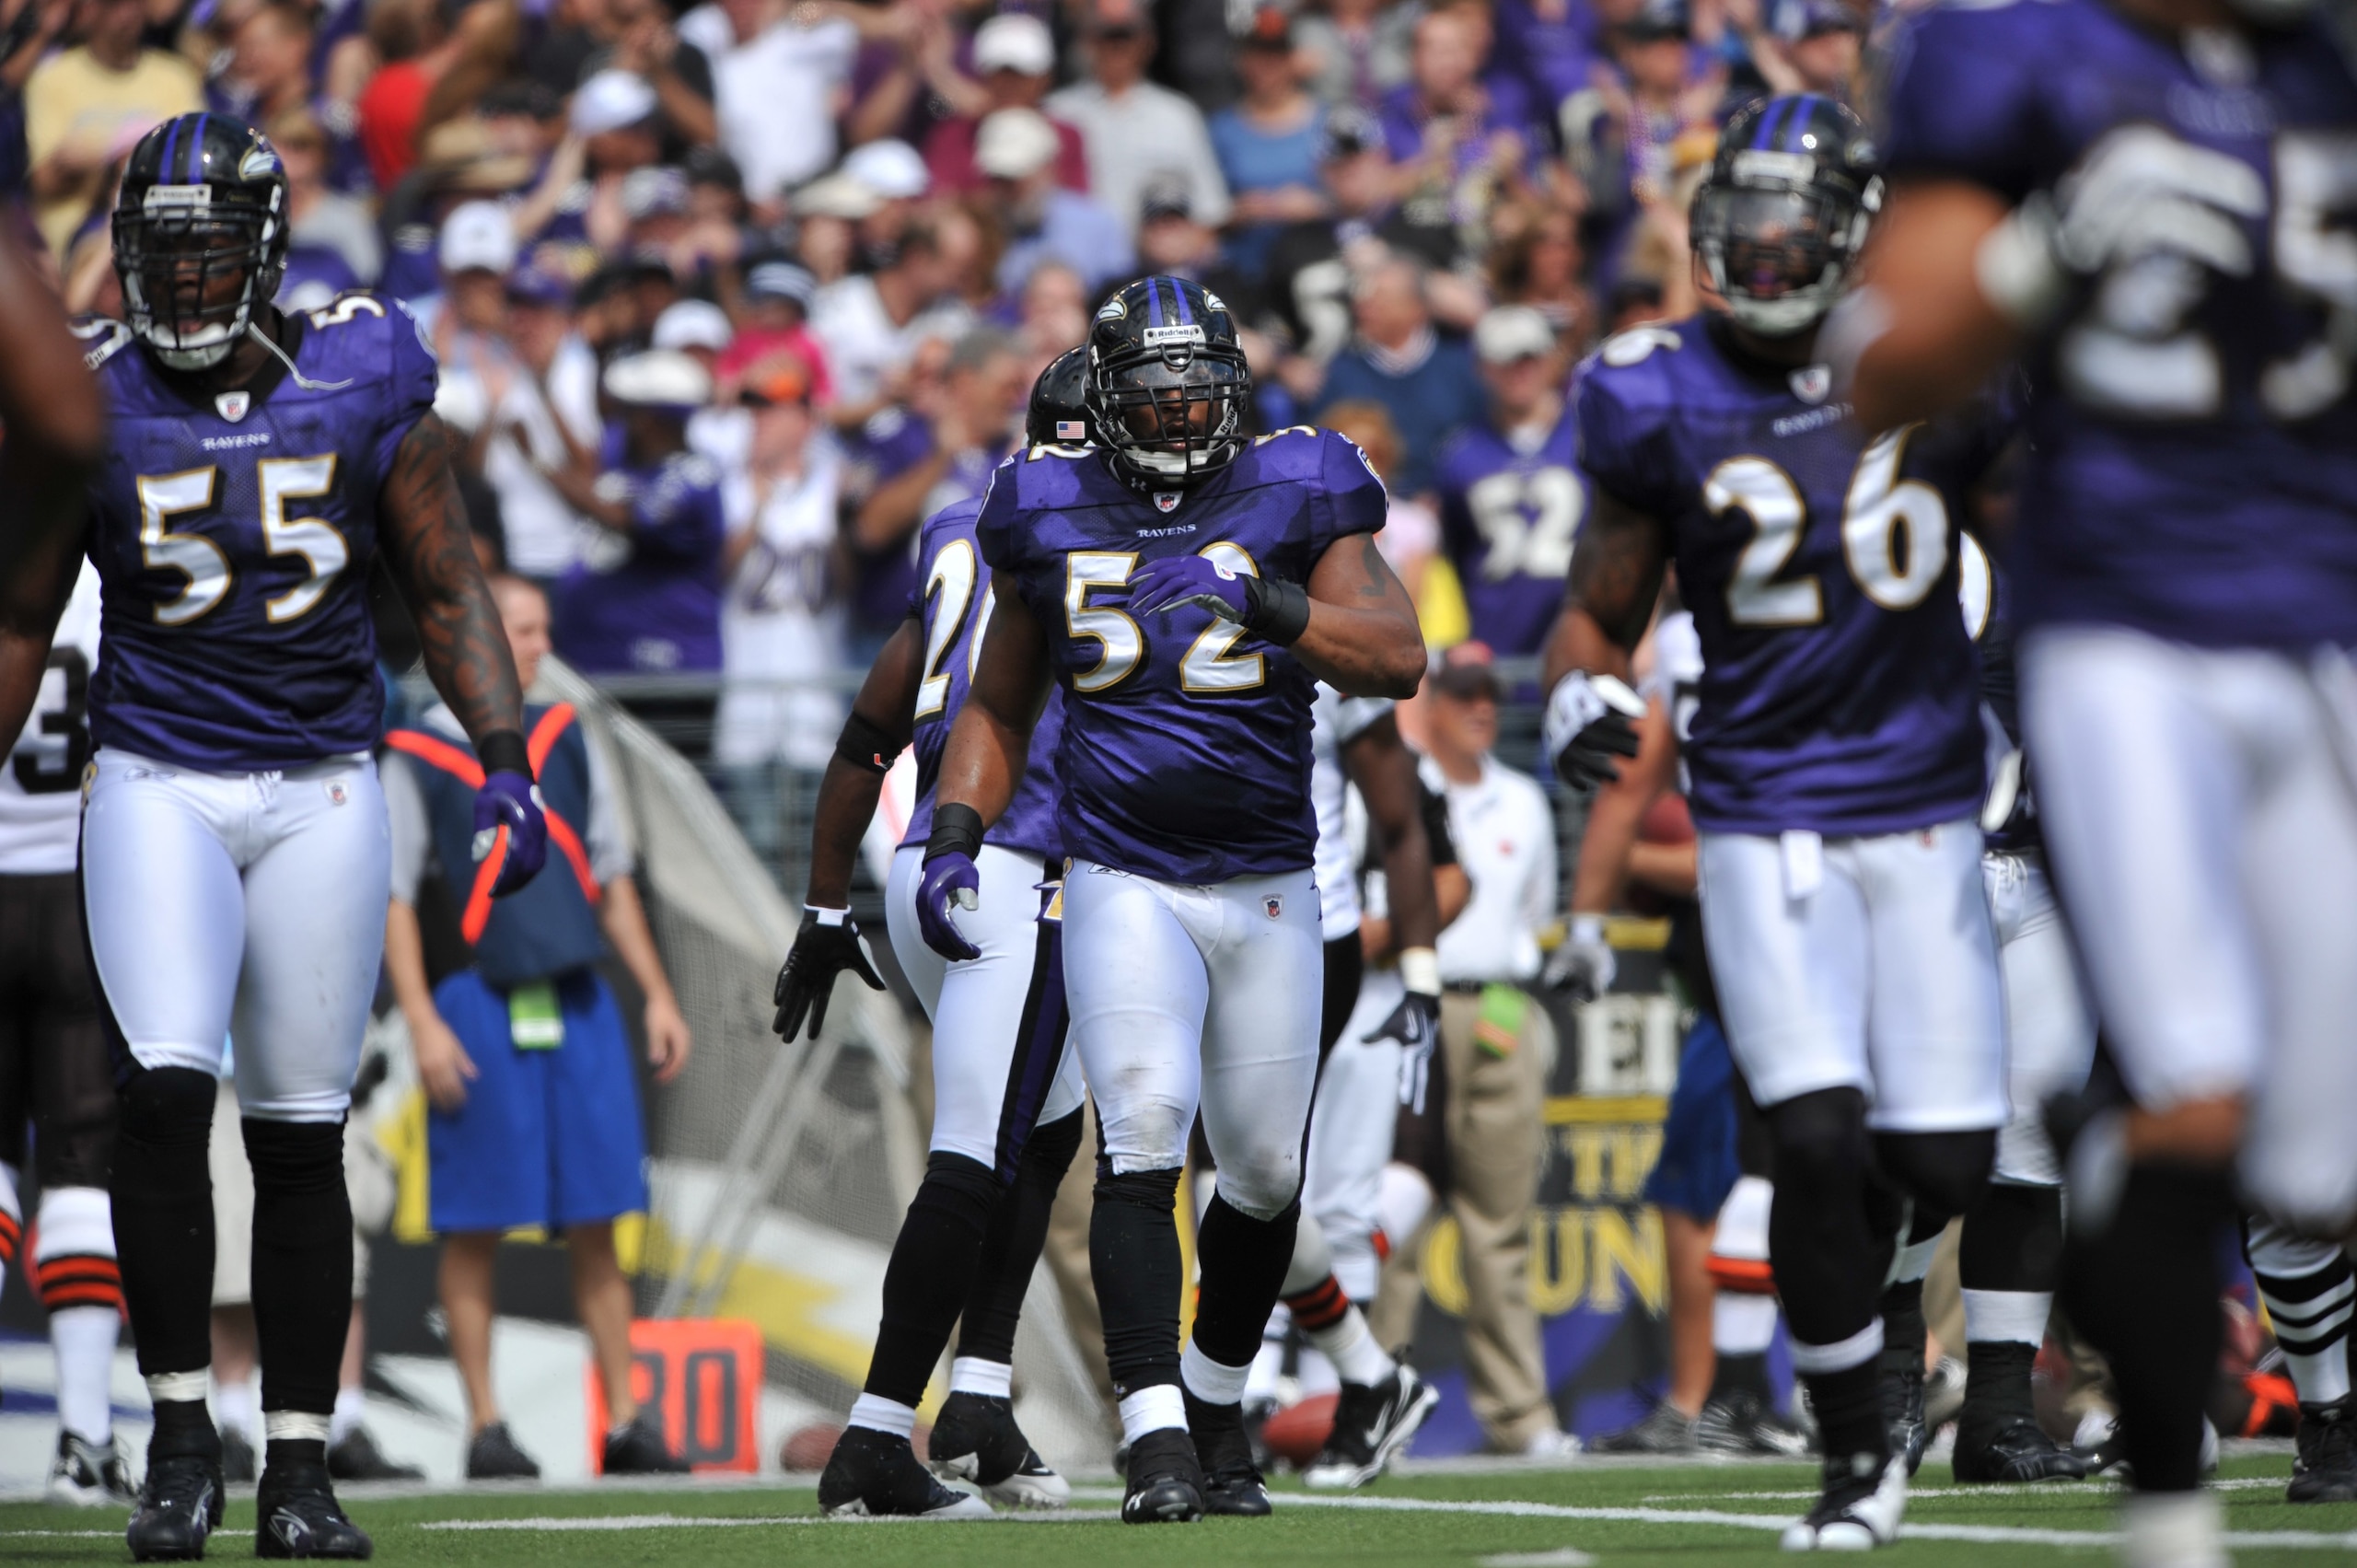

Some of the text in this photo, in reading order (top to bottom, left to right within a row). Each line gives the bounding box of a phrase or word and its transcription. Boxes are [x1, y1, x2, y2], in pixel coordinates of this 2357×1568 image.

[1157, 329, 1190, 337] Riddell
[200, 433, 270, 449] RAVENS
[136, 452, 349, 626] 55
[1137, 524, 1196, 538] RAVENS
[1468, 468, 1585, 582] 52
[1703, 421, 1950, 625] 26
[1065, 541, 1265, 692] 52
